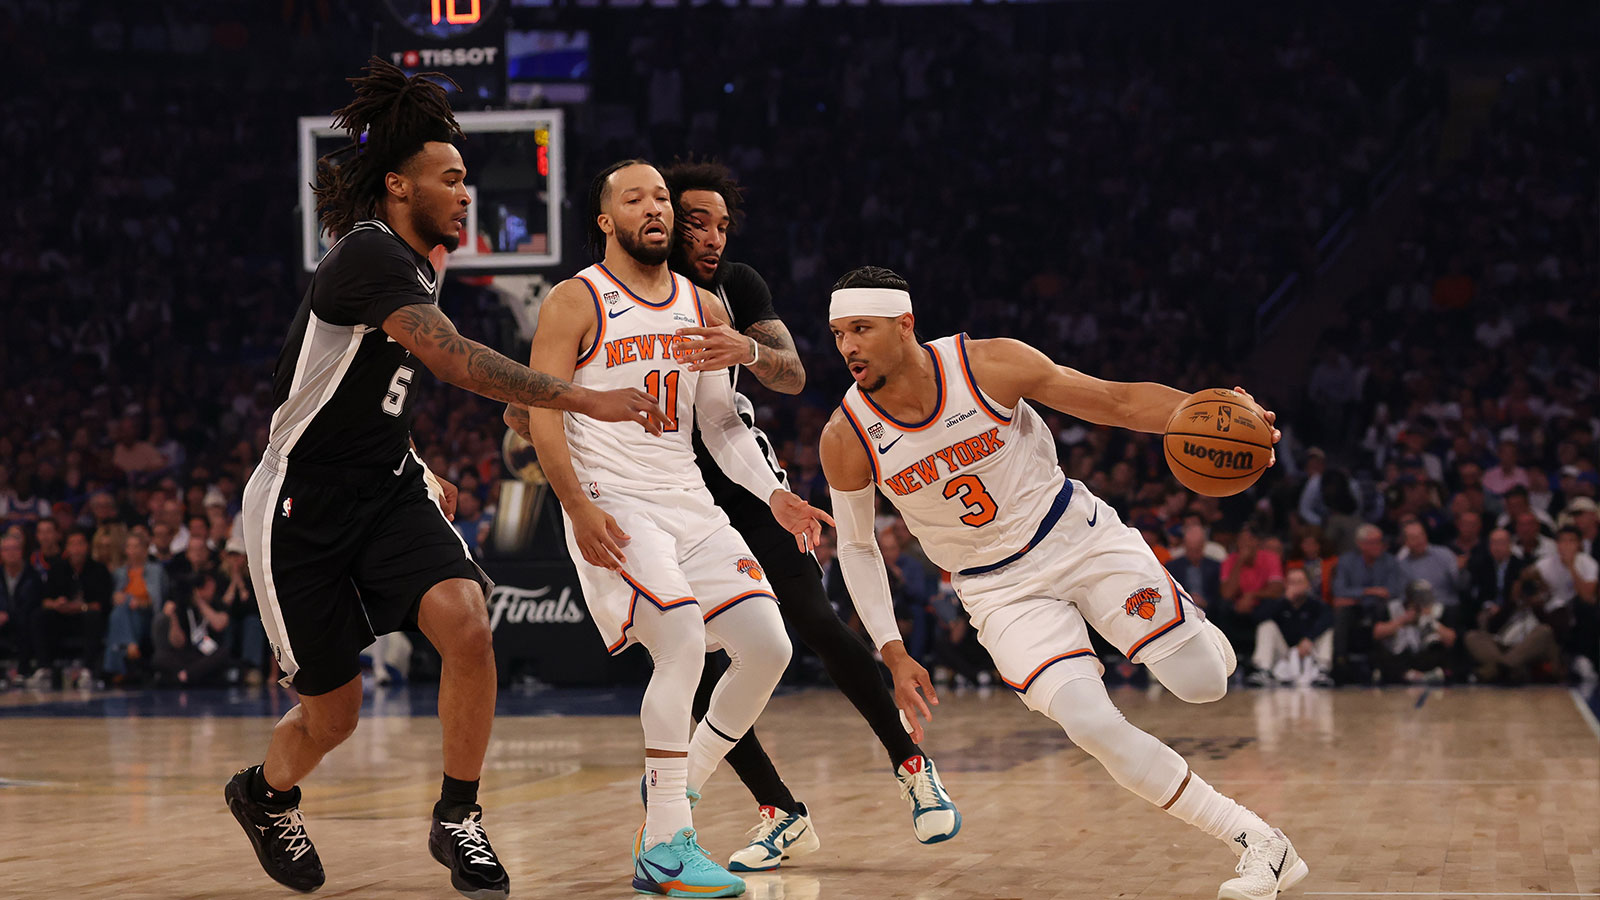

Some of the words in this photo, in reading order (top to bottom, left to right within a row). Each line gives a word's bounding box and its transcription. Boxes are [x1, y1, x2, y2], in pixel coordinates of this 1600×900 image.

[420, 47, 498, 67] TISSOT
[605, 334, 656, 368] NEW
[381, 364, 415, 418] 5
[644, 370, 680, 433] 11
[946, 417, 959, 428] abu
[959, 408, 978, 421] dhabi
[884, 454, 940, 496] NEW
[936, 427, 1005, 473] YORK
[1183, 440, 1253, 469] Wilson
[942, 474, 998, 528] 3
[488, 585, 585, 632] Finals
[1126, 588, 1162, 615] KNICKS
